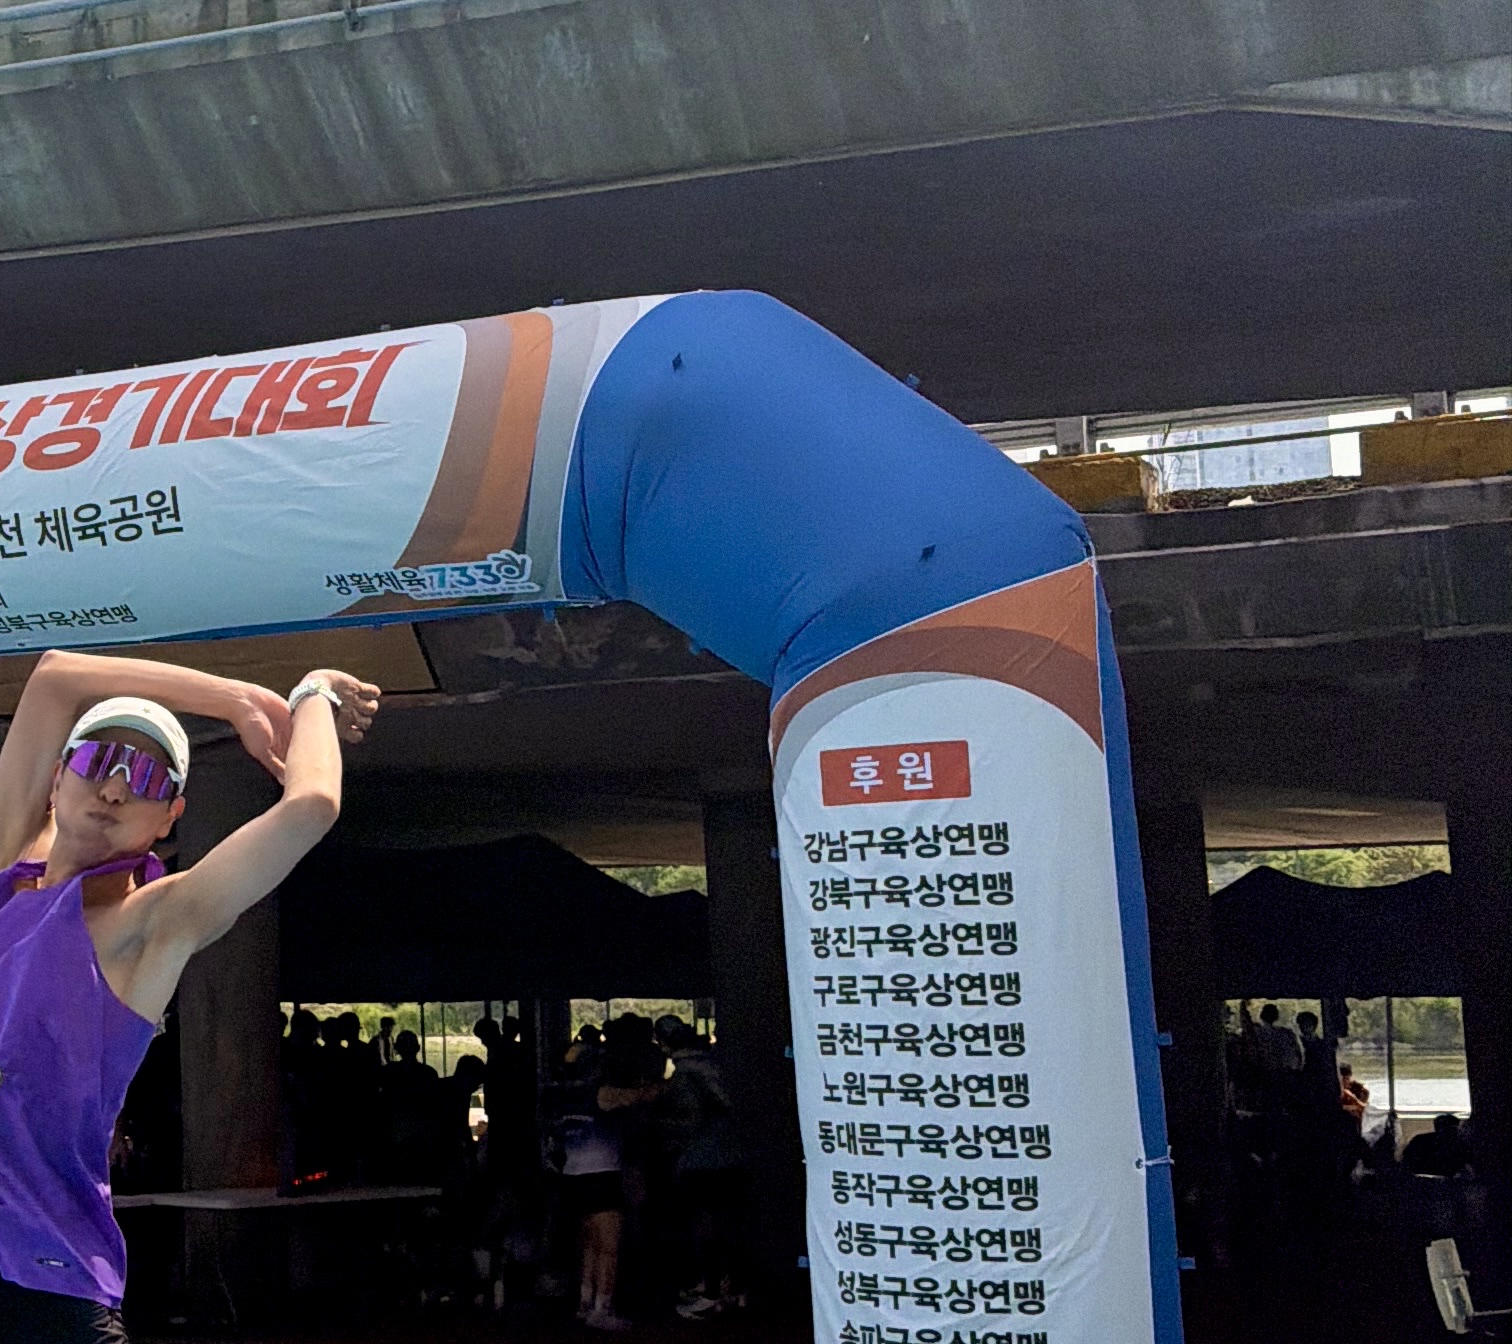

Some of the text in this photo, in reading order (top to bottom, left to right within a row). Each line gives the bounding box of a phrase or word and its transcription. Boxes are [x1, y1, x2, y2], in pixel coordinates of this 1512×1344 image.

[34, 486, 184, 553] 체육공원
[849, 751, 934, 795] 후원
[804, 822, 1010, 864] 강남구육상연맹
[809, 872, 1014, 911] 강북구육상연맹
[810, 922, 1018, 959] 광진구육상연맹
[813, 972, 1022, 1007] 구로구육상연맹
[817, 1022, 1026, 1057] 금천구육상연맹
[823, 1072, 1031, 1108] 노원구육상연맹
[818, 1121, 1052, 1159] 동대문구육상연맹
[831, 1171, 1039, 1211] 동작구육상연맹
[834, 1220, 1043, 1263] 성동구육상연맹
[837, 1270, 1046, 1316] 성북구육상연맹
